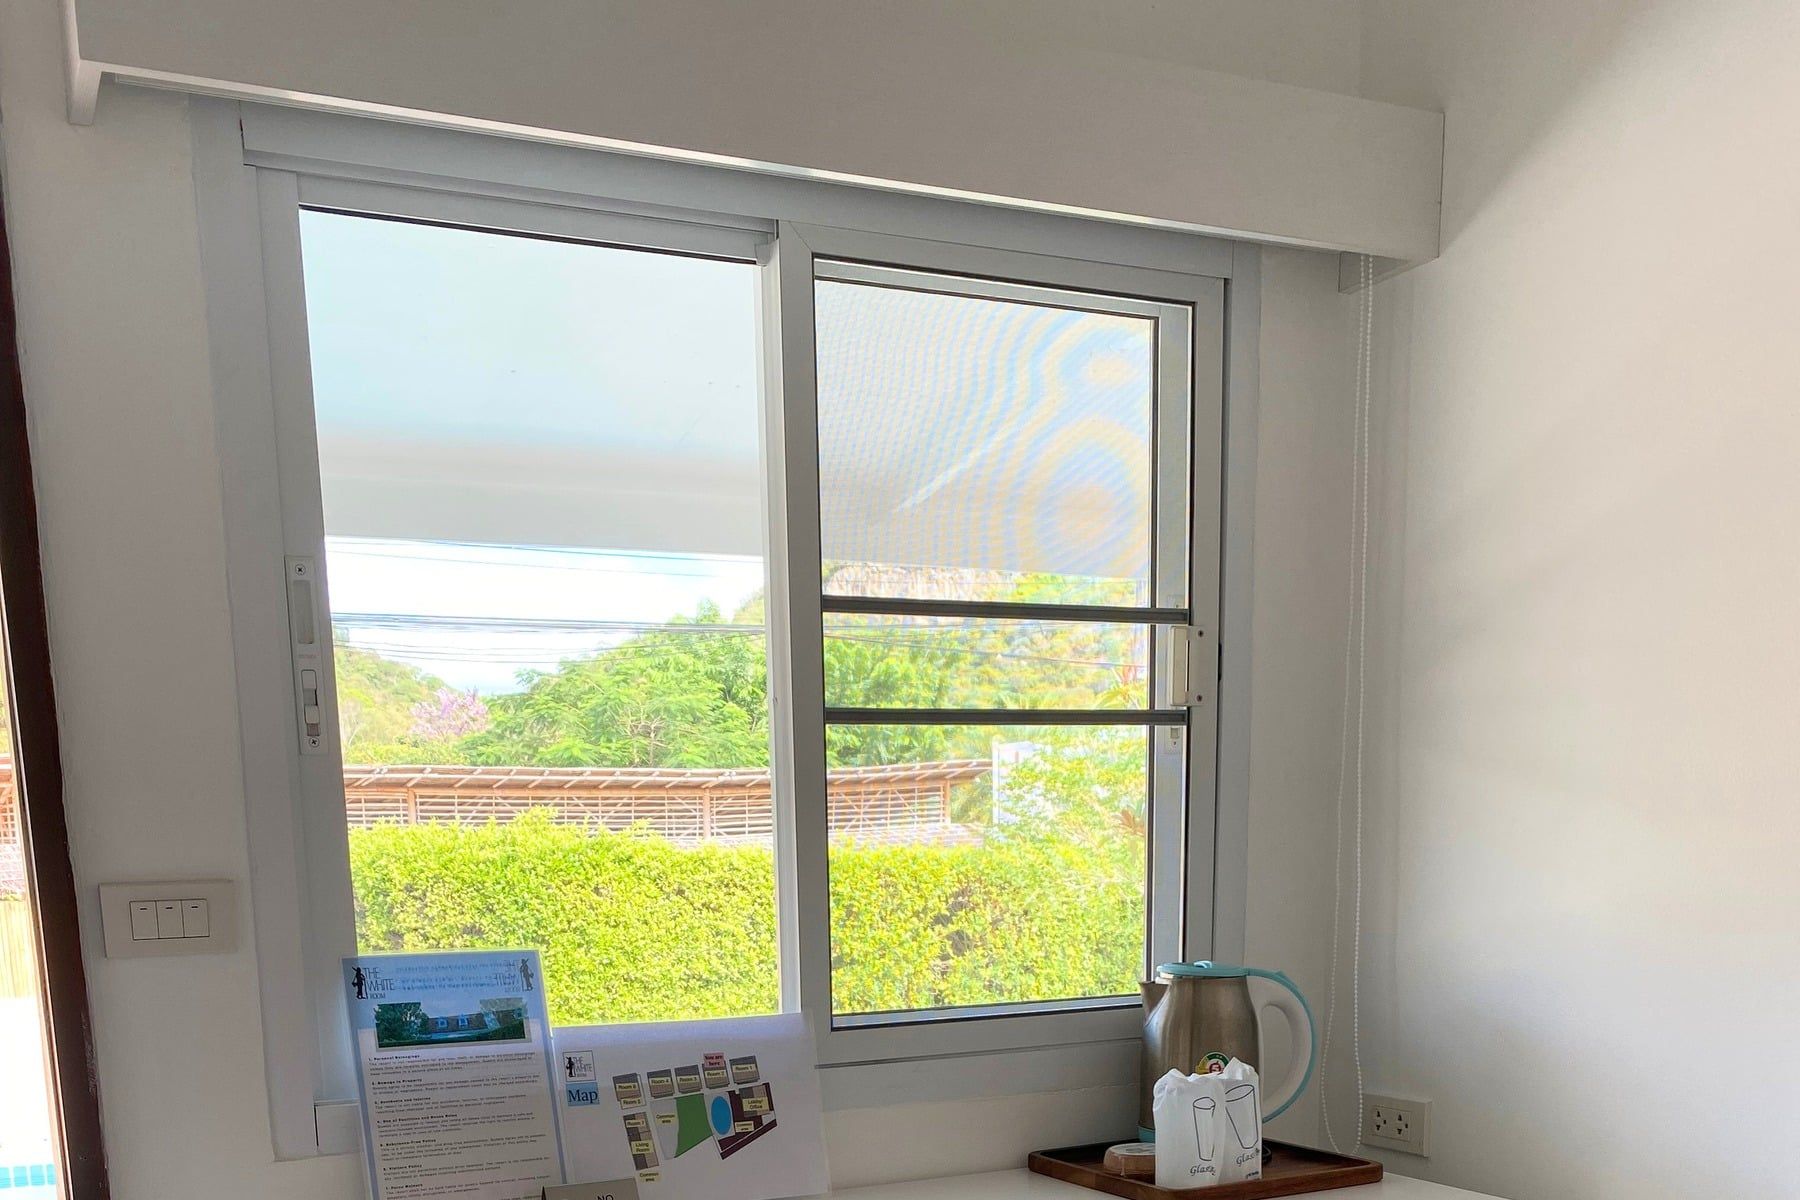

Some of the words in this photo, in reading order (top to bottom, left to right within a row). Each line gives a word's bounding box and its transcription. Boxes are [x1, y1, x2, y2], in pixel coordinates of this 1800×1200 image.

[363, 967, 381, 980] THE
[366, 978, 396, 992] WHITE
[567, 1089, 599, 1105] Map
